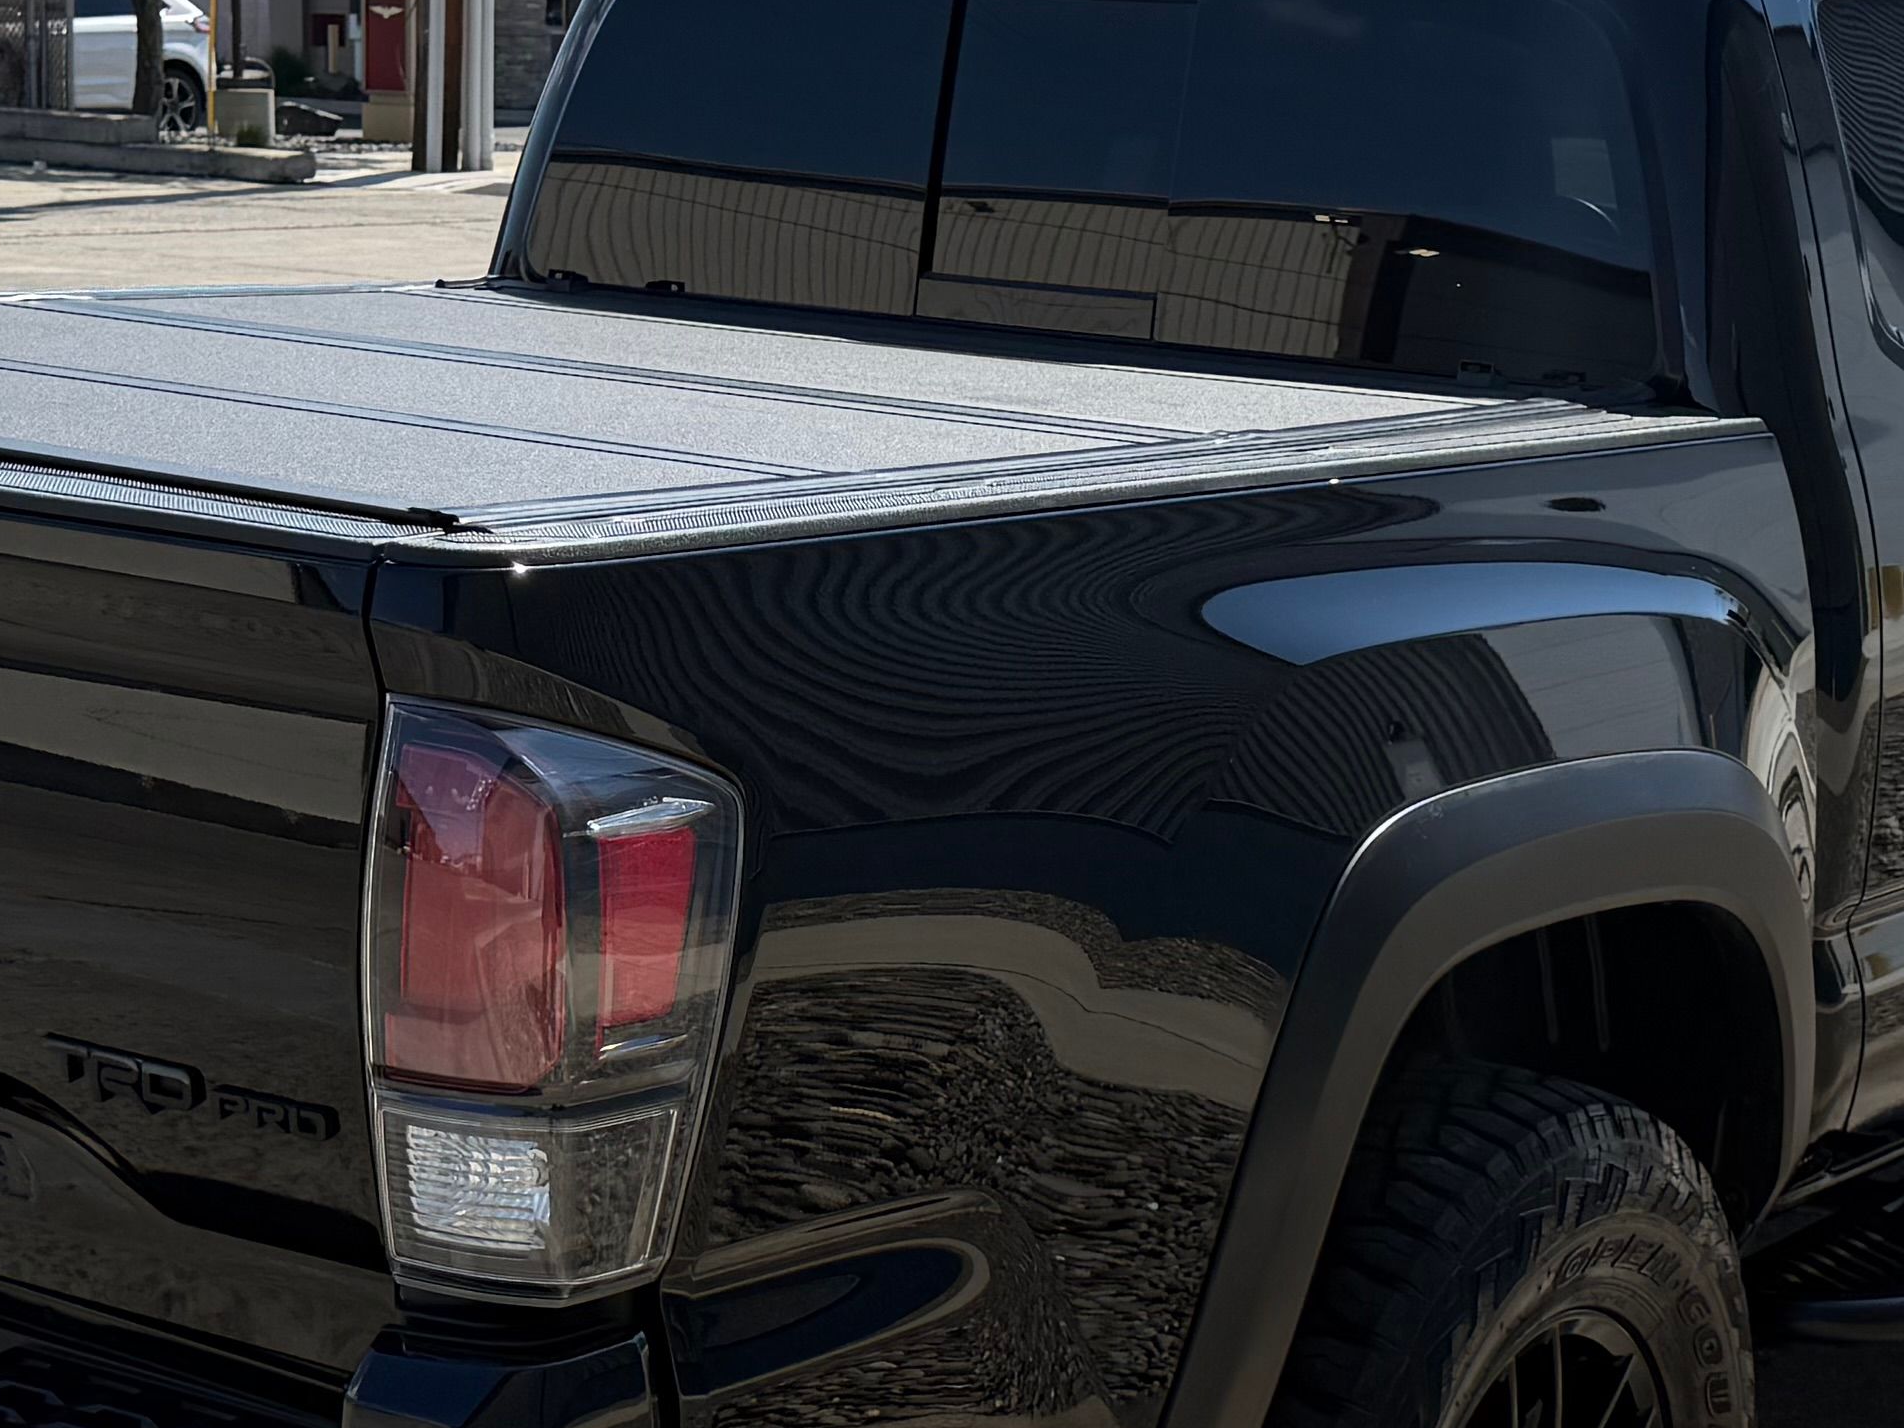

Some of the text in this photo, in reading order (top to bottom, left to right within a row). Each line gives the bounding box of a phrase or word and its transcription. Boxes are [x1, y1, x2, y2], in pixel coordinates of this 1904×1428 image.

[43, 1032, 341, 1142] TRD PRO
[1554, 1234, 1682, 1289] OPEN
